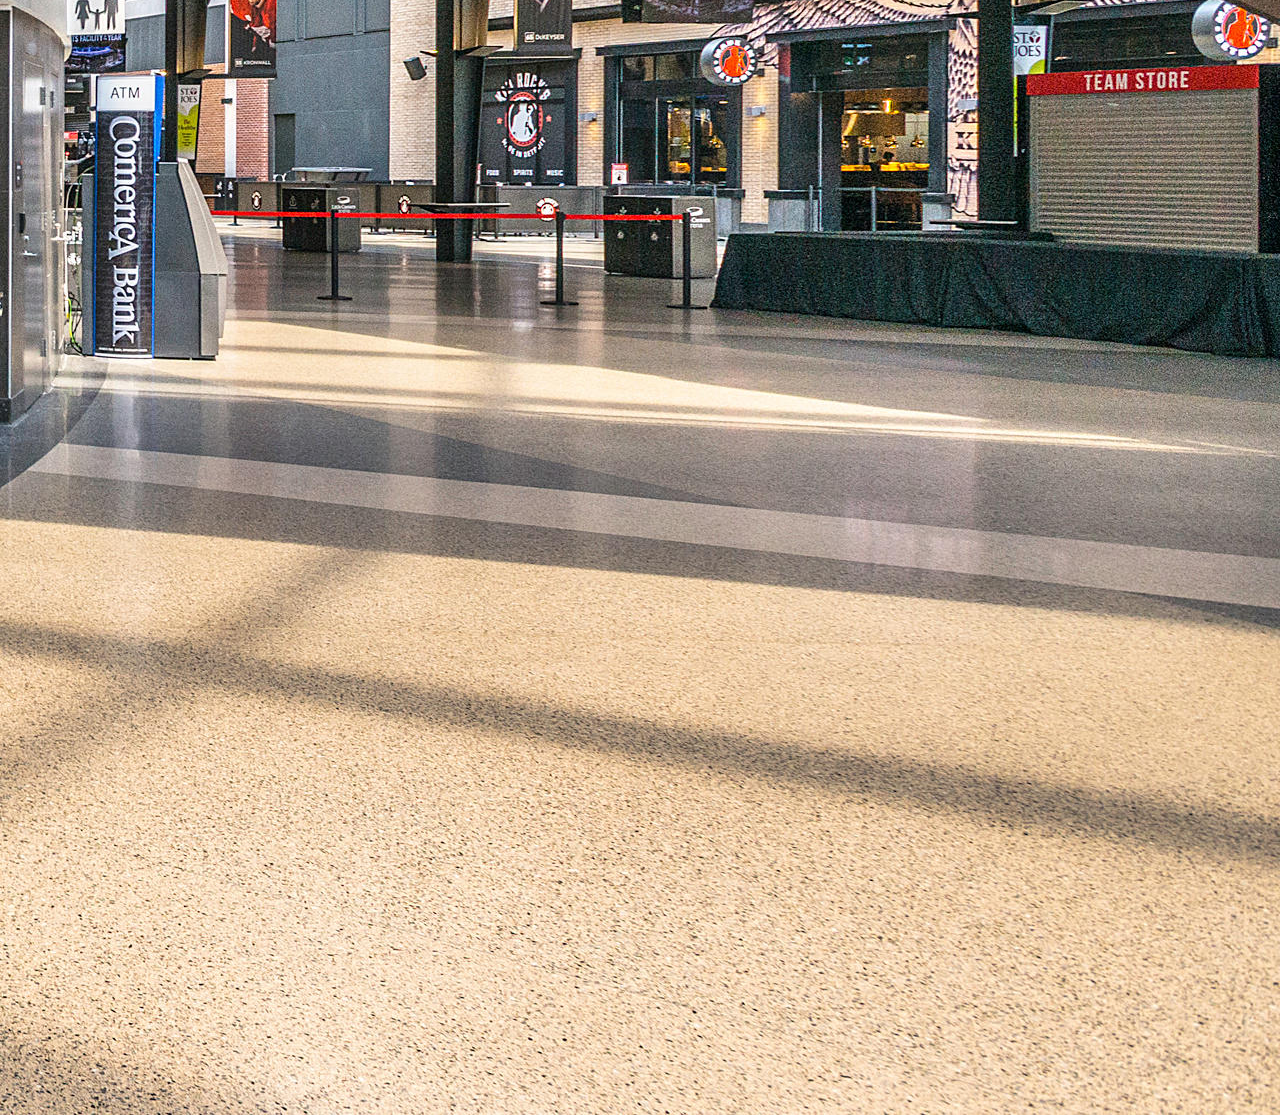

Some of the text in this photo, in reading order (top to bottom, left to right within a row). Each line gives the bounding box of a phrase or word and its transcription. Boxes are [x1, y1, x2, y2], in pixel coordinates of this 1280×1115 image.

[1084, 70, 1190, 91] TEAM STORE
[110, 86, 140, 99] ATM
[112, 265, 141, 347] Bank
